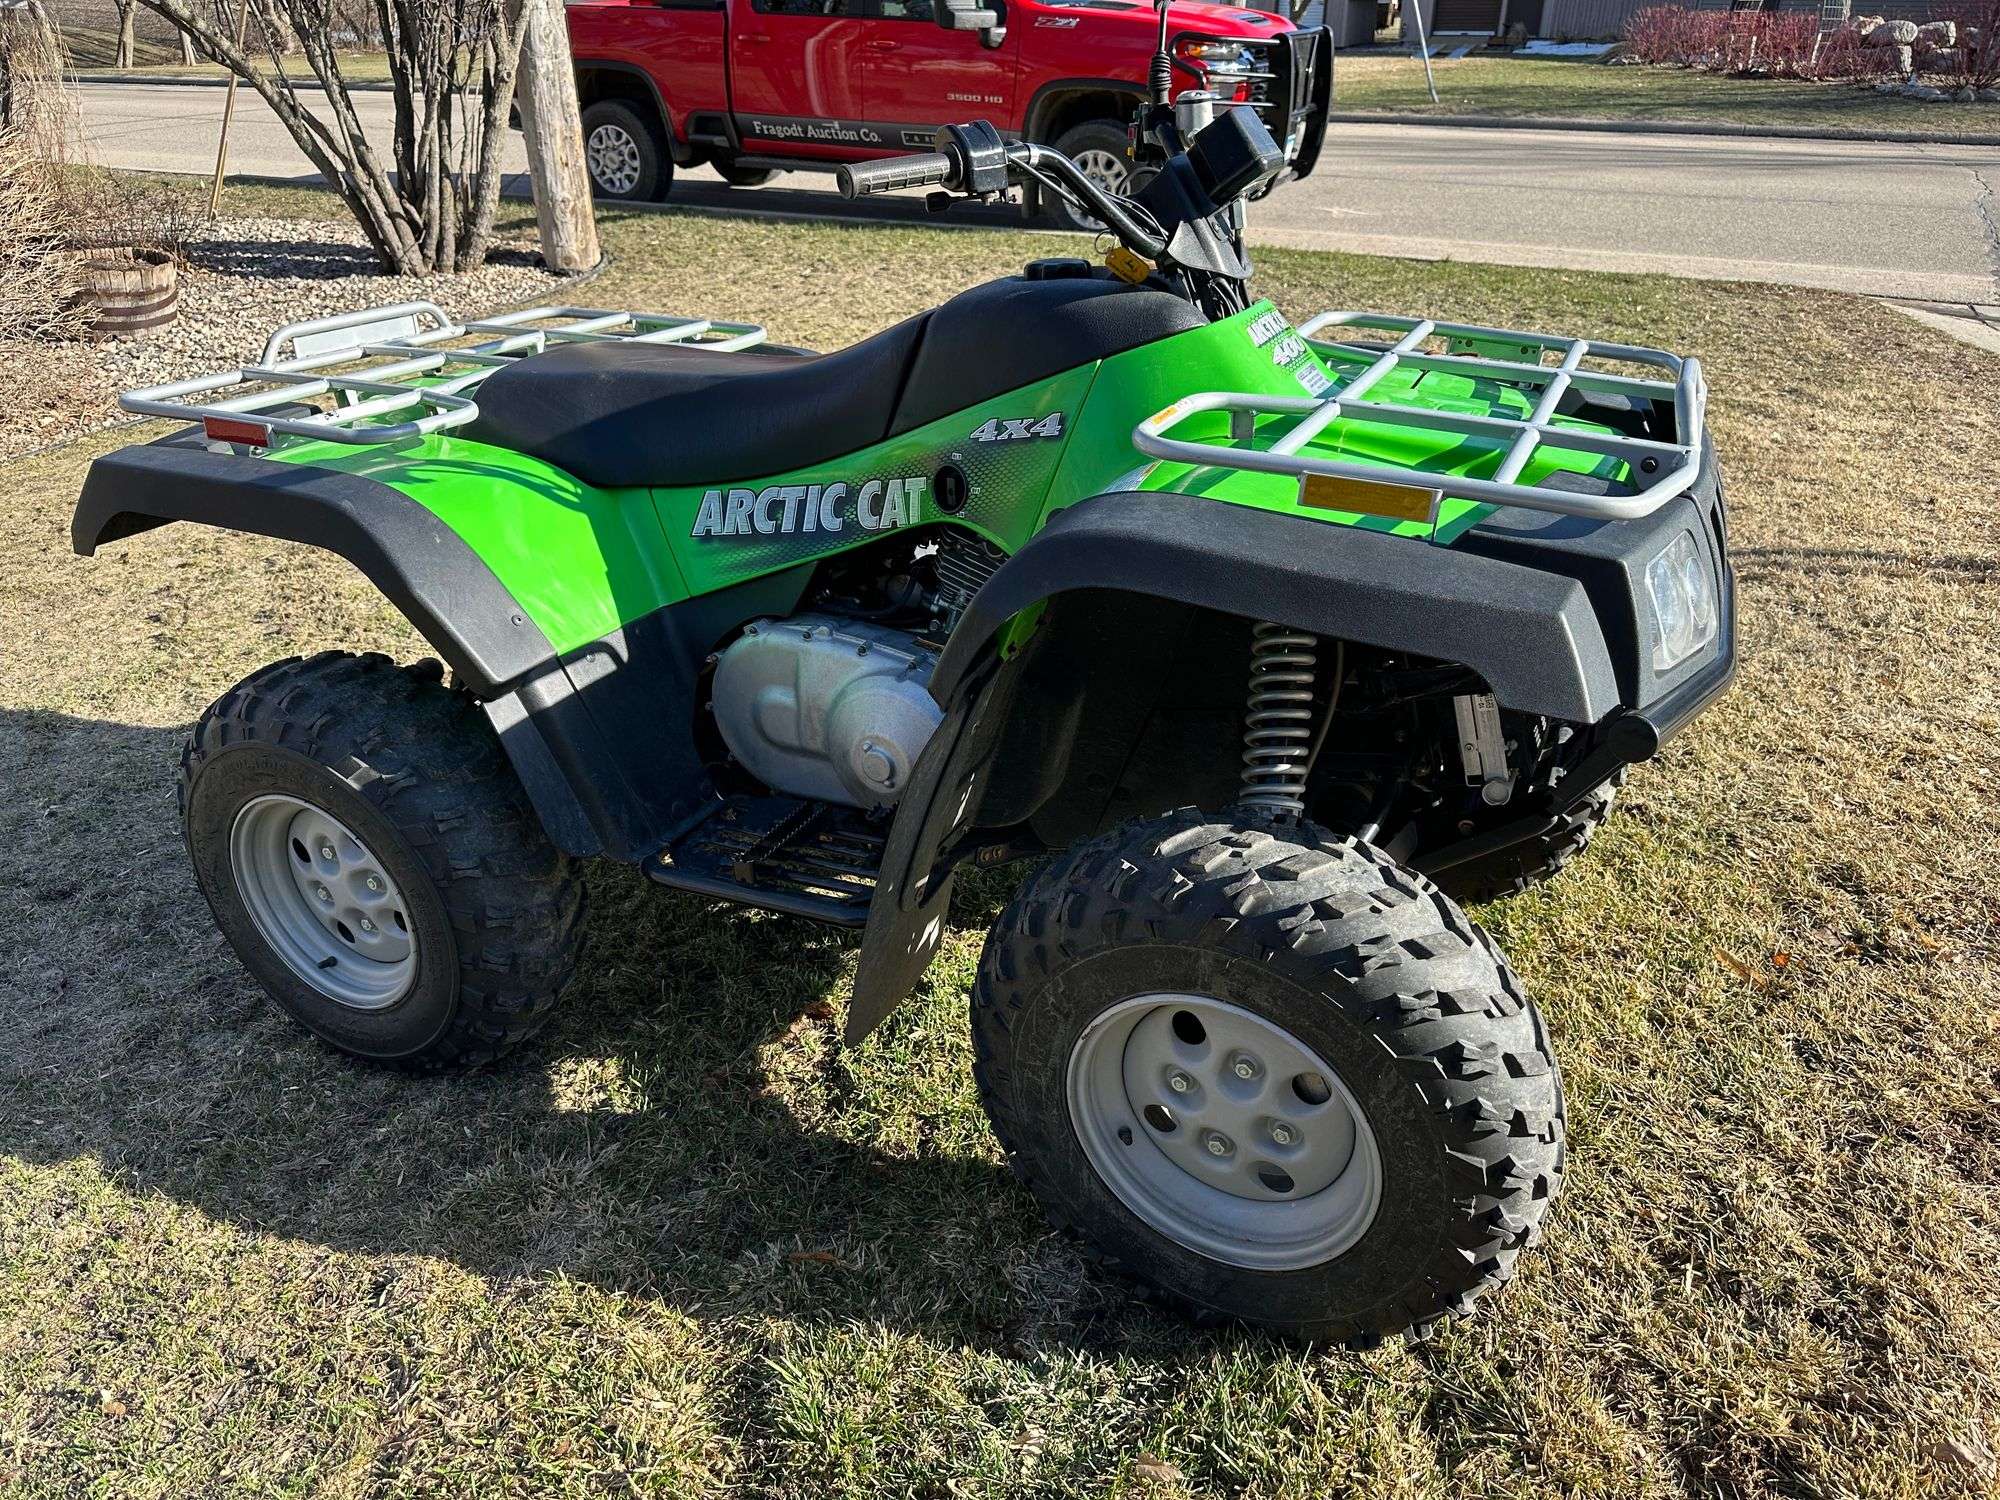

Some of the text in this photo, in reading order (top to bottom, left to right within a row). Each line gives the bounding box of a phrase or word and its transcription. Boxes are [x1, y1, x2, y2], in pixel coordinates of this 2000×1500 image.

[946, 93, 1003, 104] 3500 HD
[752, 120, 882, 142] Fragodt Auction Co.
[692, 476, 927, 536] ARCTIC CAT
